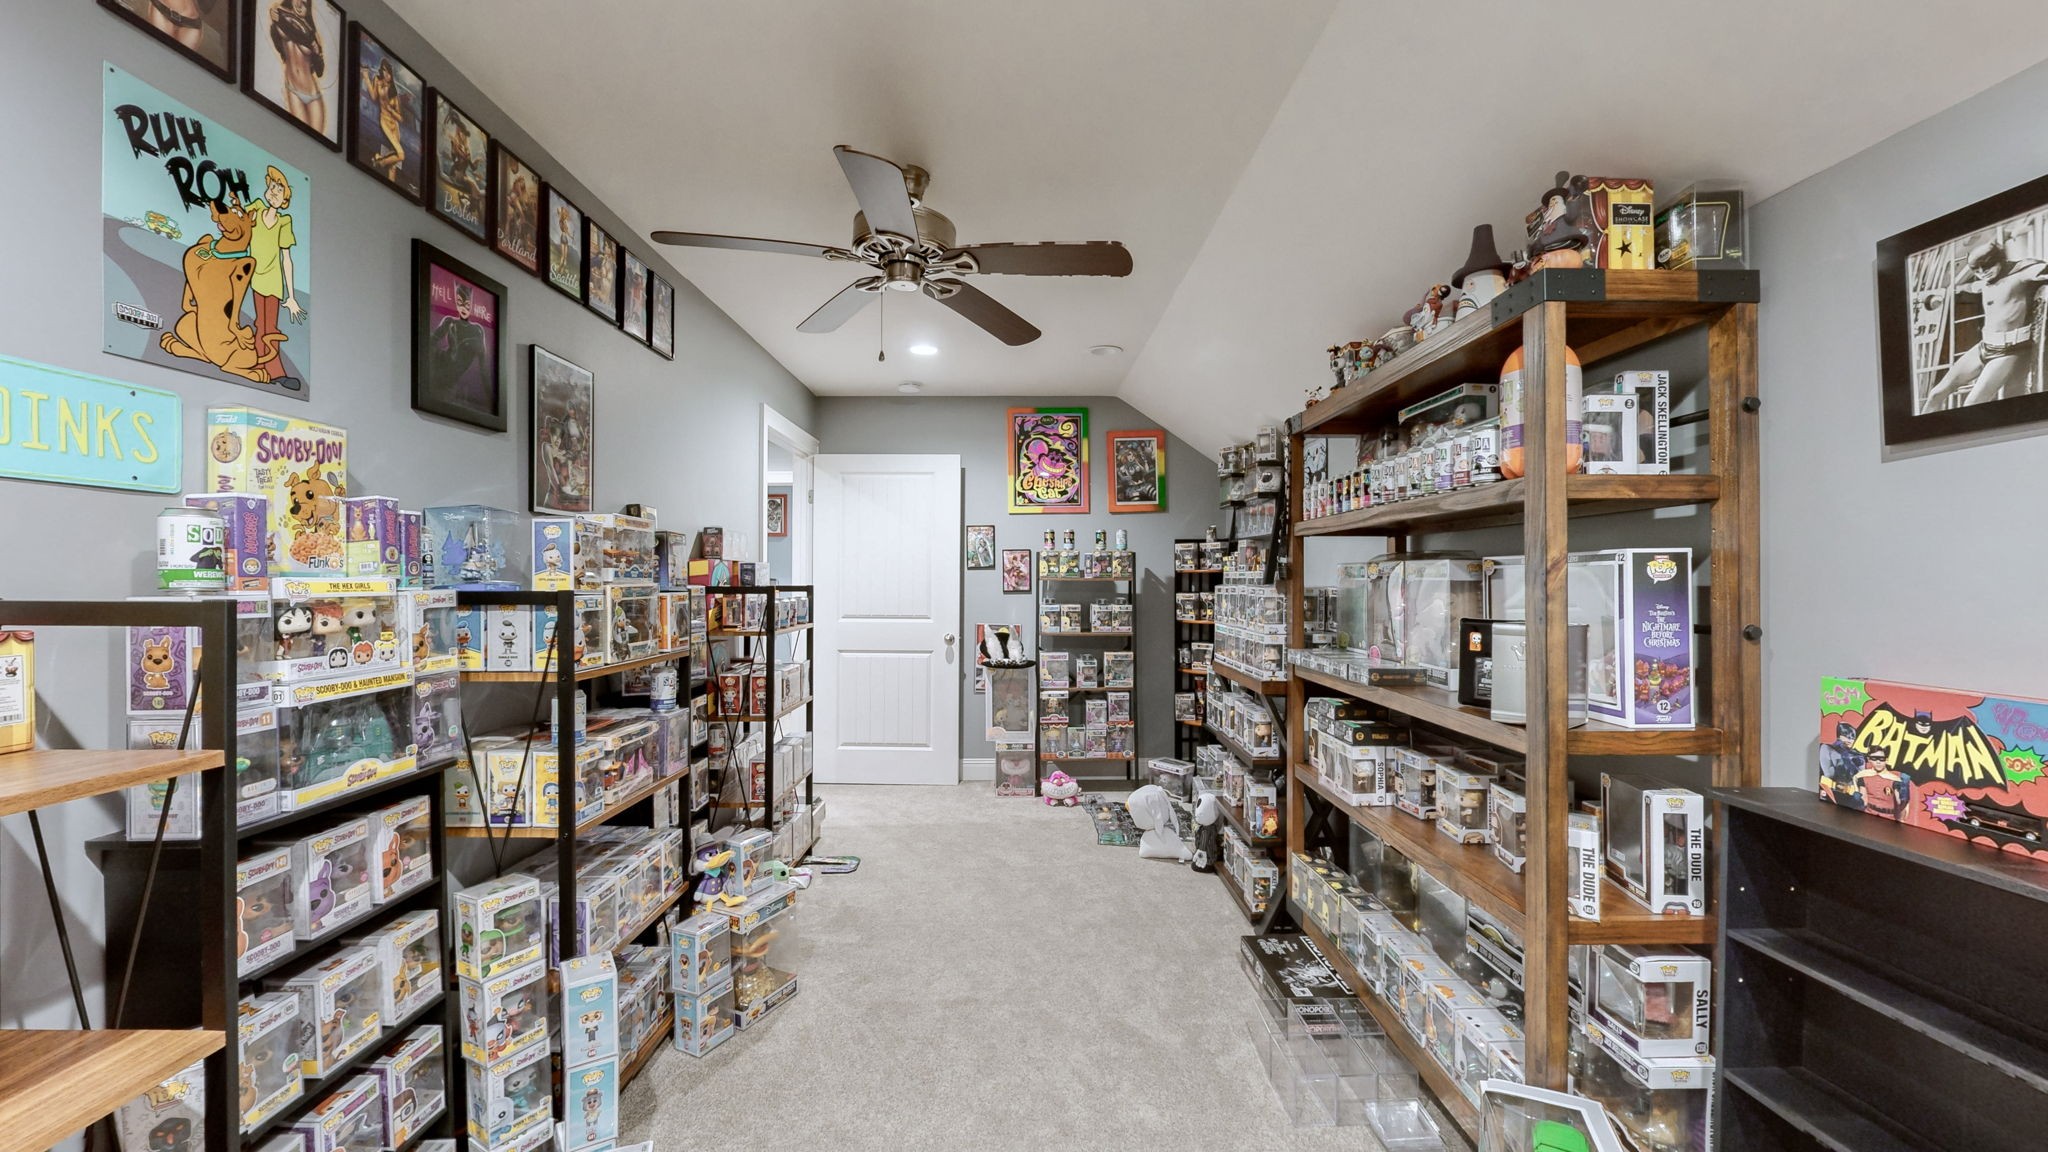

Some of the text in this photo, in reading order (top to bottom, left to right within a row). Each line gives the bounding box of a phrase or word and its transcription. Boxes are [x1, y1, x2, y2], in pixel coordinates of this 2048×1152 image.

[115, 104, 208, 158] RUH
[165, 155, 251, 212] ROH
[443, 190, 478, 225] Boston
[1618, 204, 1645, 216] Disney
[497, 227, 537, 262] Portland
[549, 262, 580, 290] Seattle
[1656, 373, 1668, 465] JACK SKELLINGTON
[256, 431, 343, 466] SCOOBY-DOO!
[1038, 487, 1061, 499] Cat
[187, 524, 223, 545] SOD
[1617, 553, 1625, 562] 12
[193, 571, 224, 579] WEREW
[355, 582, 371, 590] GIRLS
[1642, 621, 1682, 632] NIGHTMARE
[1651, 630, 1674, 639] BEFORE
[1643, 637, 1681, 648] CHRISTMAS
[316, 682, 352, 694] SCOOBY-DOO
[359, 677, 382, 689] HAUNTED
[383, 672, 406, 684] MANSION
[273, 693, 283, 701] 01
[1659, 702, 1668, 711] 12
[149, 731, 178, 744] POP!
[1853, 709, 2005, 785] BATMAN
[1690, 829, 1702, 882] THE DUDE
[1582, 848, 1596, 903] THE DUDE
[245, 941, 281, 964] SCOOBY-DOO
[1296, 1006, 1333, 1014] ONOPO
[1696, 990, 1709, 1029] SALLY
